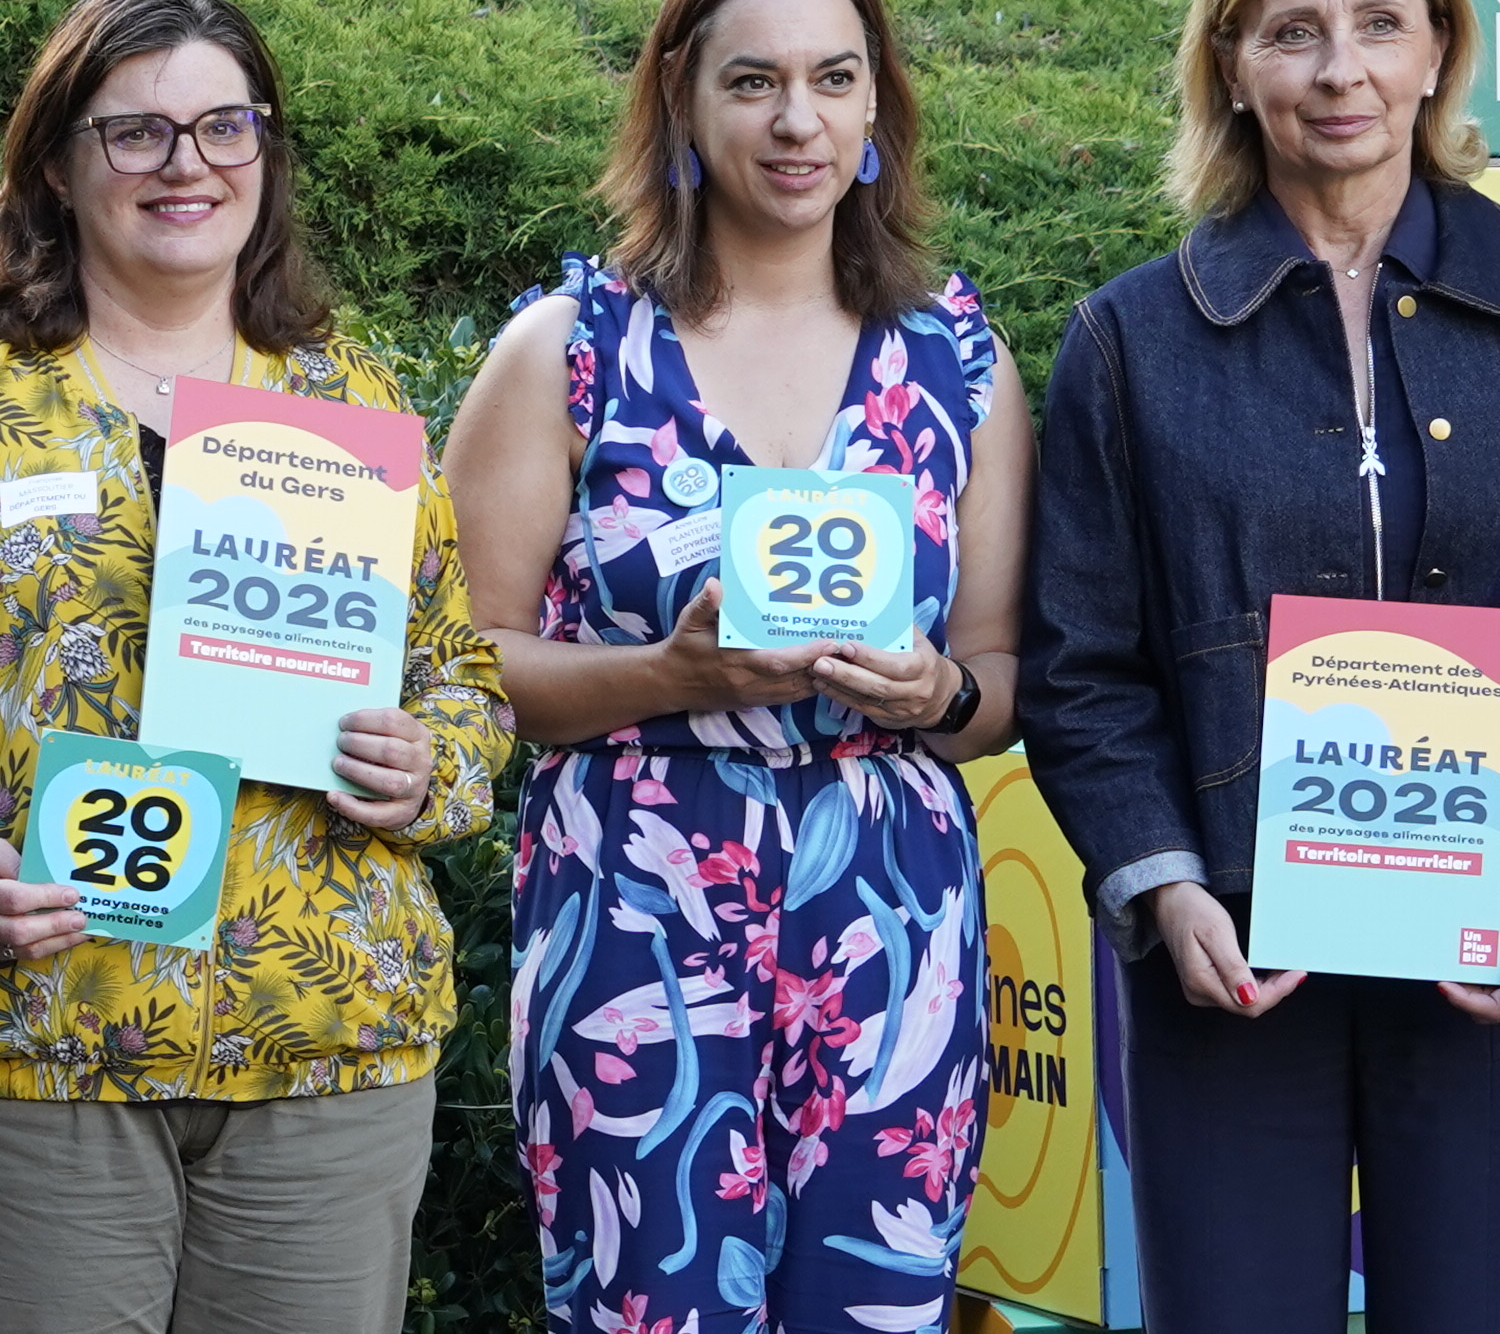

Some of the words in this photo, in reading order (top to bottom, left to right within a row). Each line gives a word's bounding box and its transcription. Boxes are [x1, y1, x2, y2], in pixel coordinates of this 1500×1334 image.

[202, 436, 388, 483] Département
[240, 470, 274, 491] du
[281, 476, 345, 502] Gers
[673, 467, 699, 486] 20
[682, 477, 707, 495] 26
[683, 533, 721, 551] PYRÉNÉE
[768, 514, 866, 560] 20
[192, 529, 378, 582] LAURÉAT
[675, 545, 721, 566] ATLANTIQU
[768, 561, 864, 607] 26
[186, 569, 378, 633] 2026
[762, 613, 789, 623] des
[792, 616, 868, 628] paysages
[767, 627, 864, 641] alimentaires
[184, 616, 208, 628] des
[212, 621, 281, 640] paysages
[284, 631, 373, 654] alimentaires
[190, 640, 272, 667] Territoire
[275, 653, 360, 680] nourricier
[1311, 655, 1443, 677] Département
[1448, 664, 1483, 679] des
[1295, 736, 1487, 776] LAURÉAT
[85, 759, 192, 787] LAURÉAT
[1292, 776, 1488, 826] 2026
[79, 789, 182, 842] 20
[1289, 824, 1315, 834] des
[1318, 826, 1389, 840] paysages
[1393, 830, 1485, 845] alimentaires
[70, 839, 172, 892] 26
[1297, 845, 1381, 865] Territoire
[1384, 853, 1472, 871] nourricier
[66, 907, 163, 929] mentaires
[91, 896, 169, 916] paysages
[1463, 931, 1481, 941] Un
[1463, 942, 1492, 953] Plus
[989, 1043, 1067, 1107] MAIN
